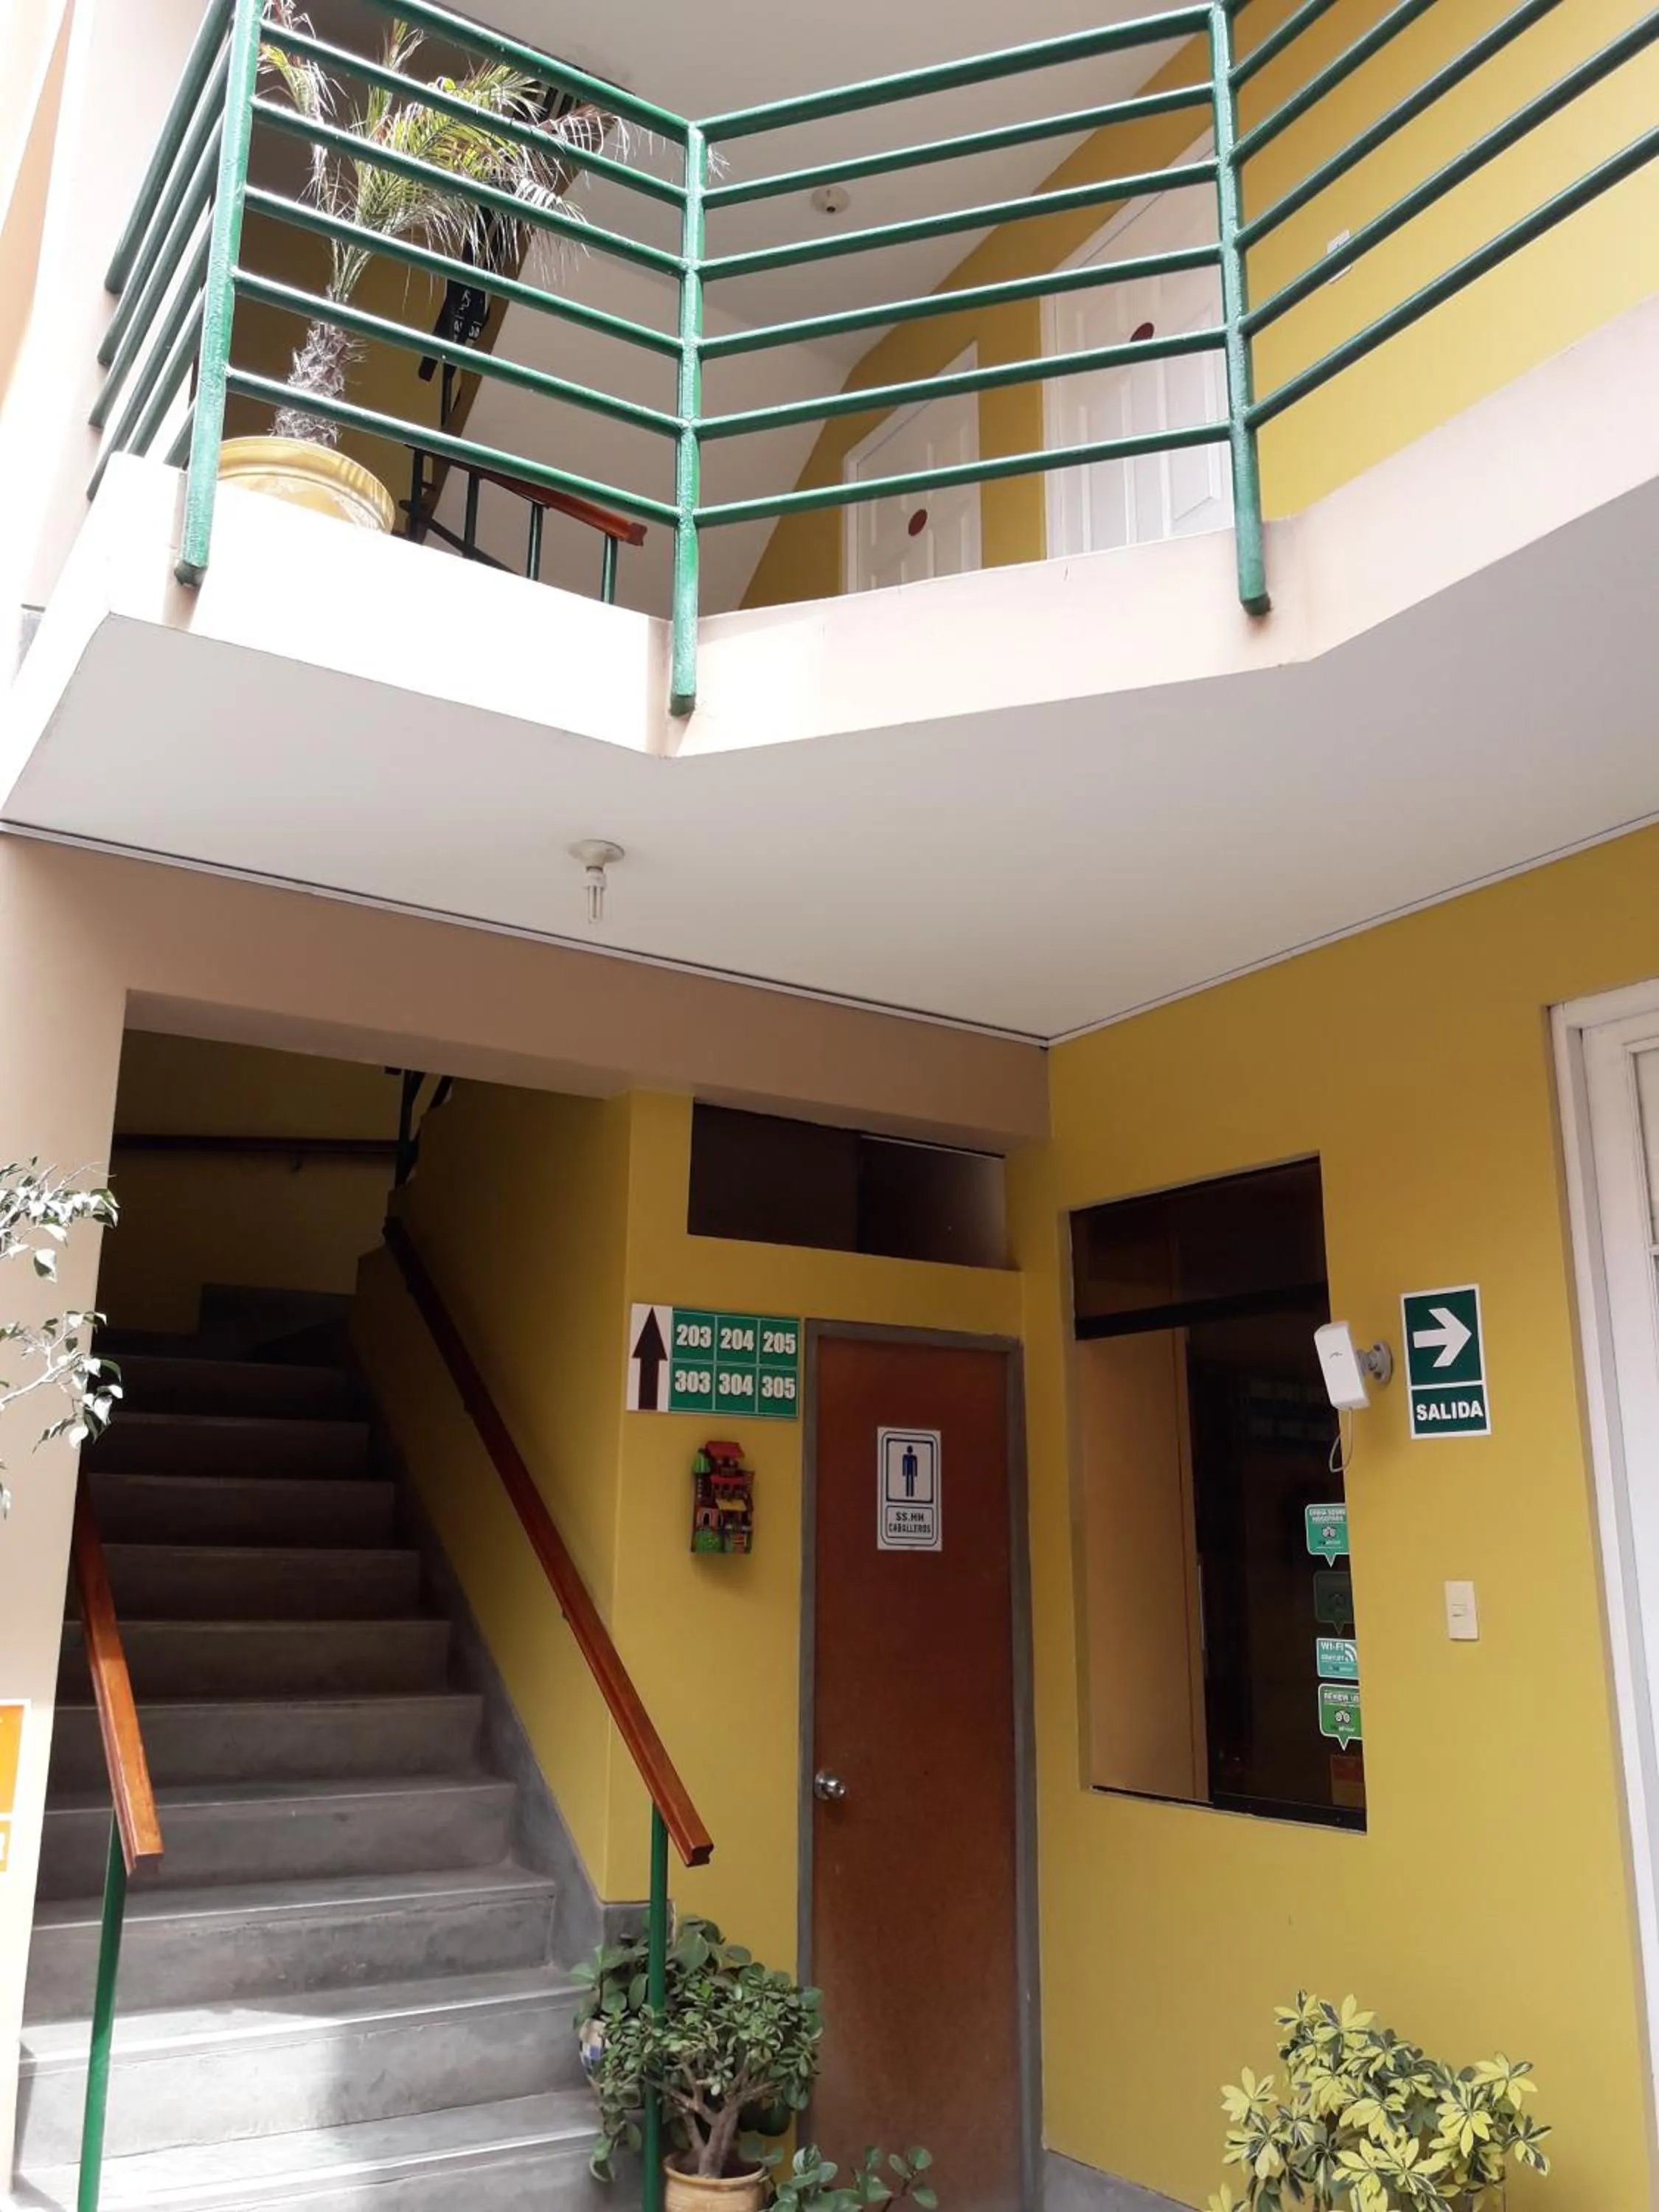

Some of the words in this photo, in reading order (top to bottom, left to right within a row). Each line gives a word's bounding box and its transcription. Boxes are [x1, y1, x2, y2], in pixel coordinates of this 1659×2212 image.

[676, 1324, 712, 1348] 203
[720, 1329, 754, 1351] 204
[762, 1331, 796, 1354] 205
[675, 1370, 711, 1394] 303
[719, 1373, 754, 1396] 304
[762, 1376, 796, 1399] 305
[1416, 1400, 1484, 1421] SALIDA
[888, 1523, 931, 1533] CABALLEROS
